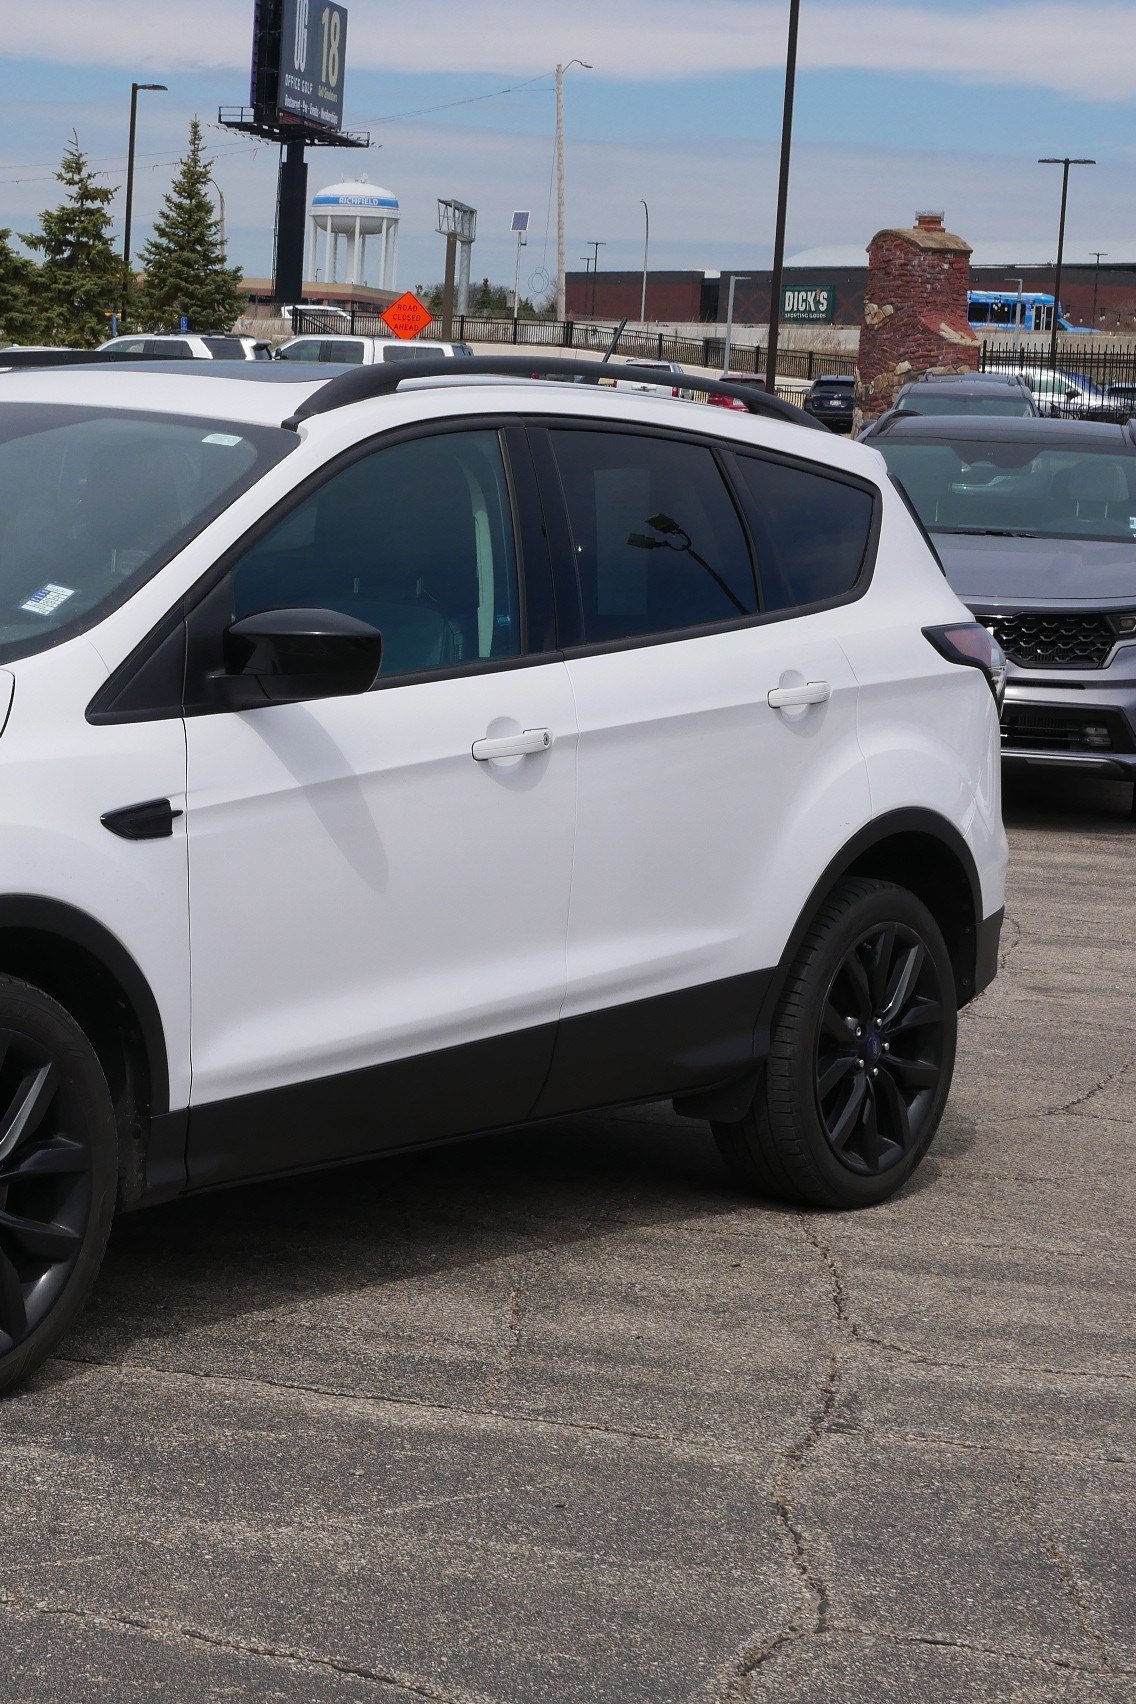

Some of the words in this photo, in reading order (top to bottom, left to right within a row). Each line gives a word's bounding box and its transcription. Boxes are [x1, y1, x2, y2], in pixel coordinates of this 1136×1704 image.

[321, 7, 341, 88] 18
[284, 73, 301, 91] OFFICE
[301, 79, 313, 95] GOLF
[338, 196, 379, 206] RICHFIELD
[784, 290, 828, 312] DICK'S
[397, 304, 418, 312] ROAD
[392, 313, 421, 322] CLOSED
[393, 323, 419, 331] AHEAD
